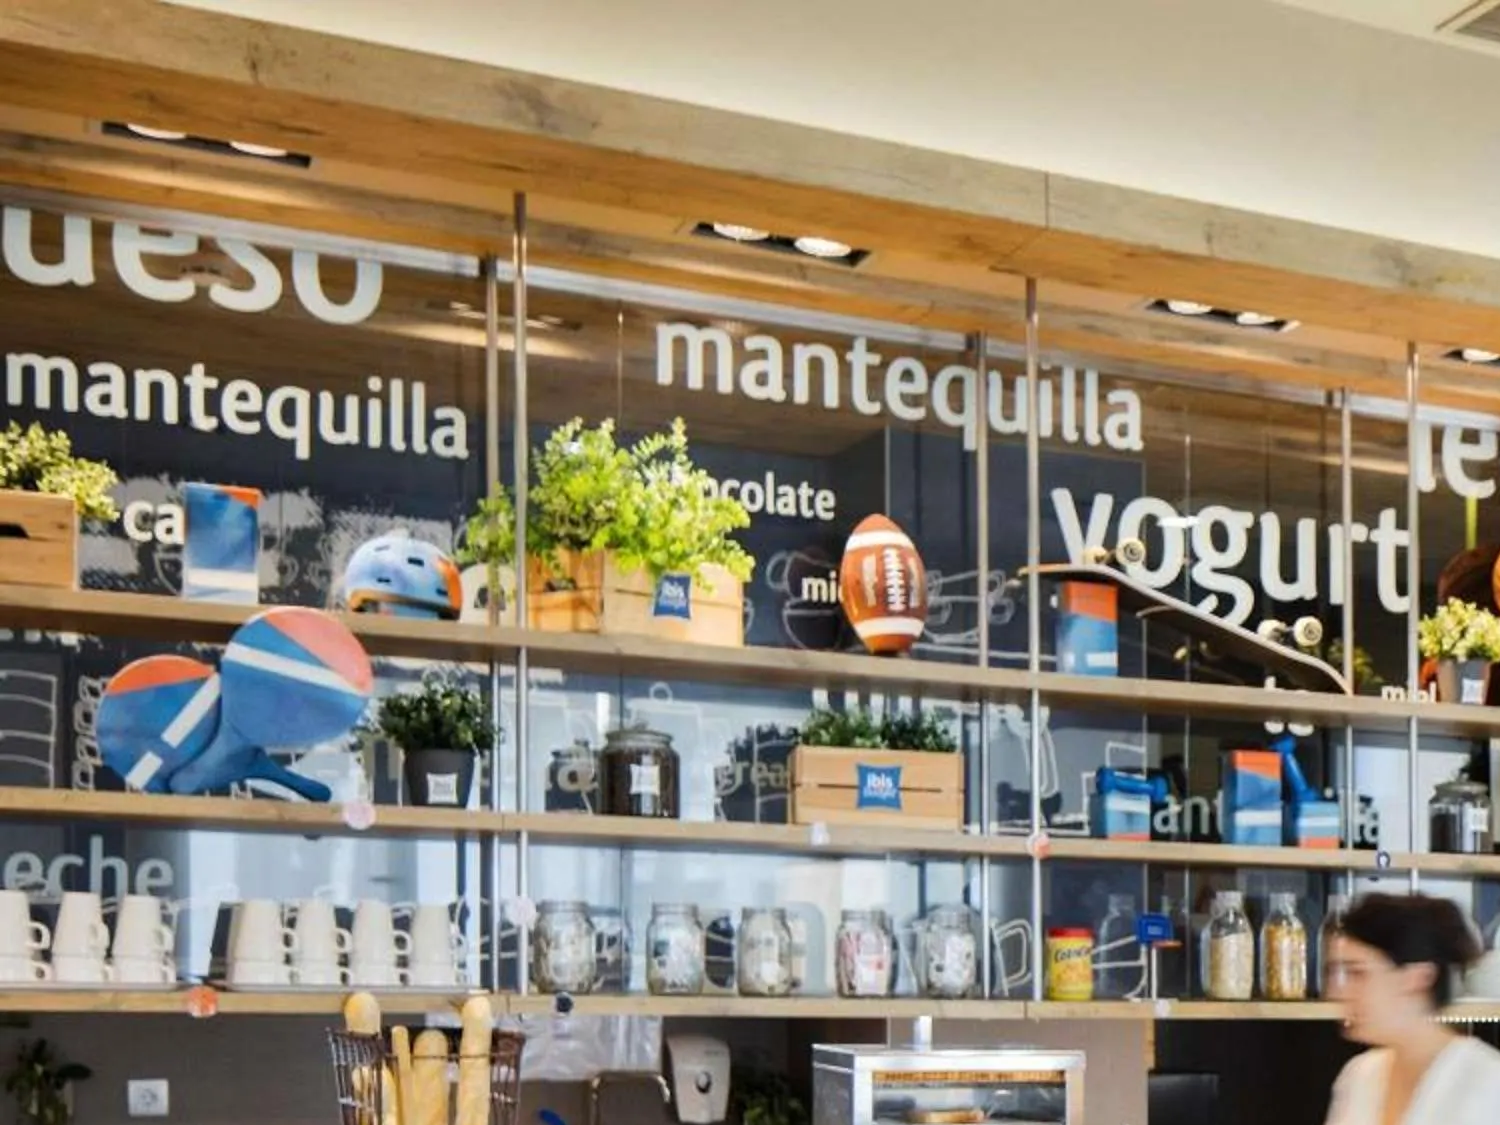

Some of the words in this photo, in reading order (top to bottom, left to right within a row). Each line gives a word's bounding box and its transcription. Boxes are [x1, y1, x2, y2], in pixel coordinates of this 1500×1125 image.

[5, 352, 470, 460] mantequilla
[656, 322, 1145, 451] mantequilla
[1050, 486, 1411, 626] yogurt
